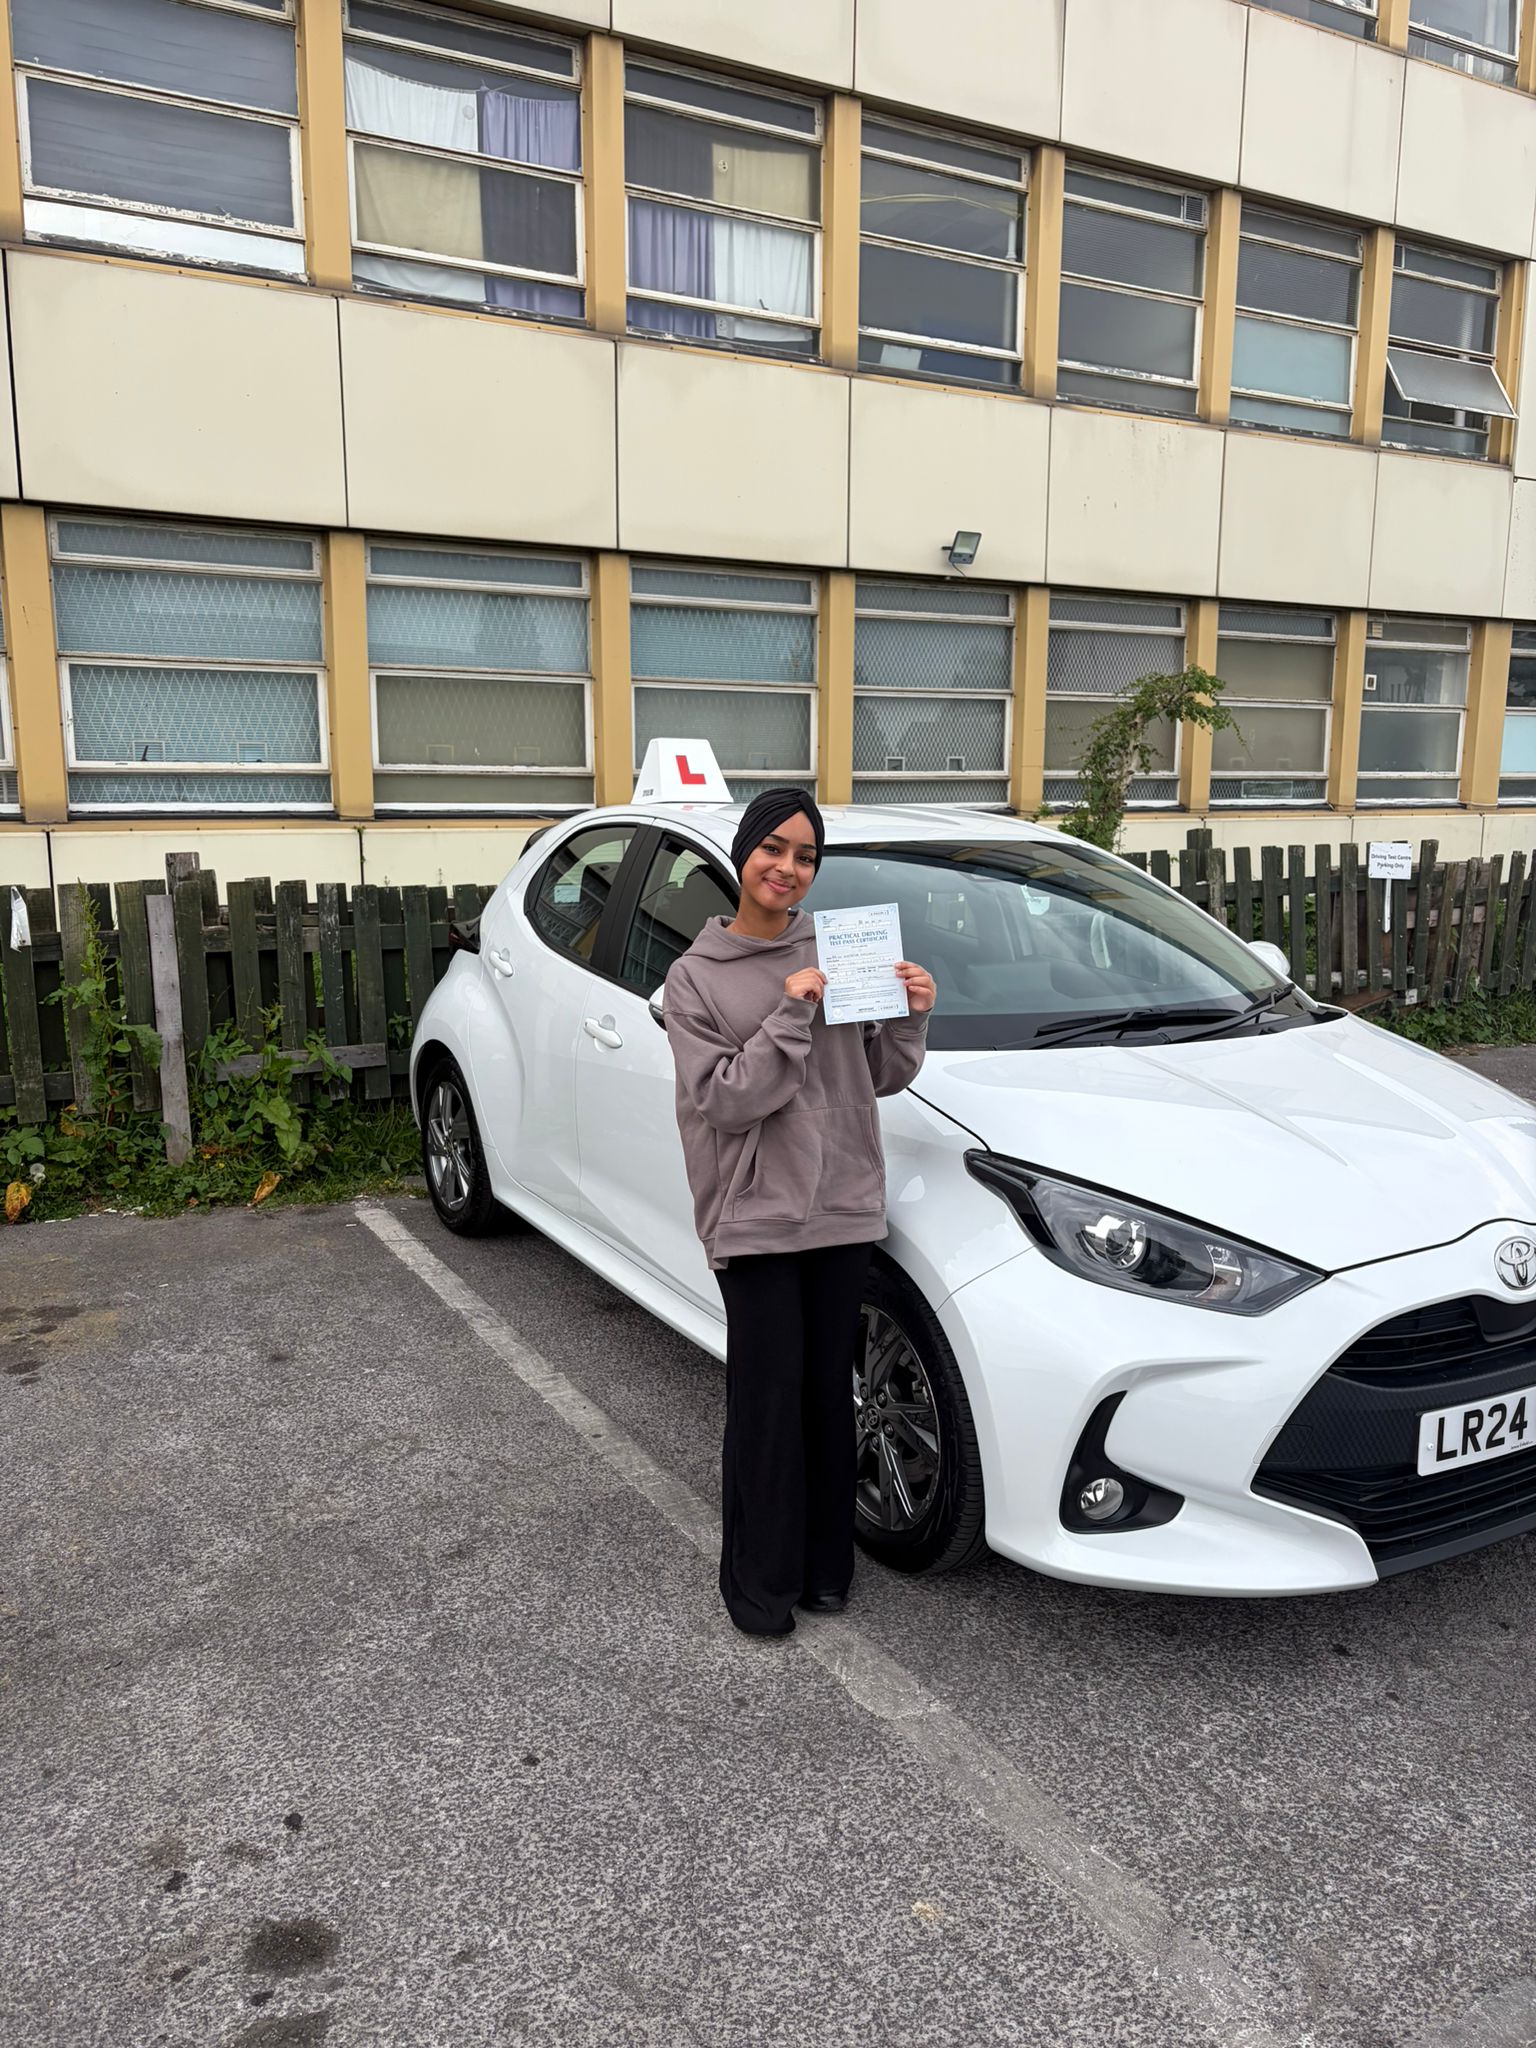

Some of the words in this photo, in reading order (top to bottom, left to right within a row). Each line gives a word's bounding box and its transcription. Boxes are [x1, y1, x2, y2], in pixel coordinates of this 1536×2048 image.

[675, 755, 706, 785] L
[828, 932, 860, 941] PRACTICAL
[861, 929, 888, 938] DRIVING
[856, 934, 888, 943] CERTIFICATE
[1436, 1396, 1528, 1462] LR24
